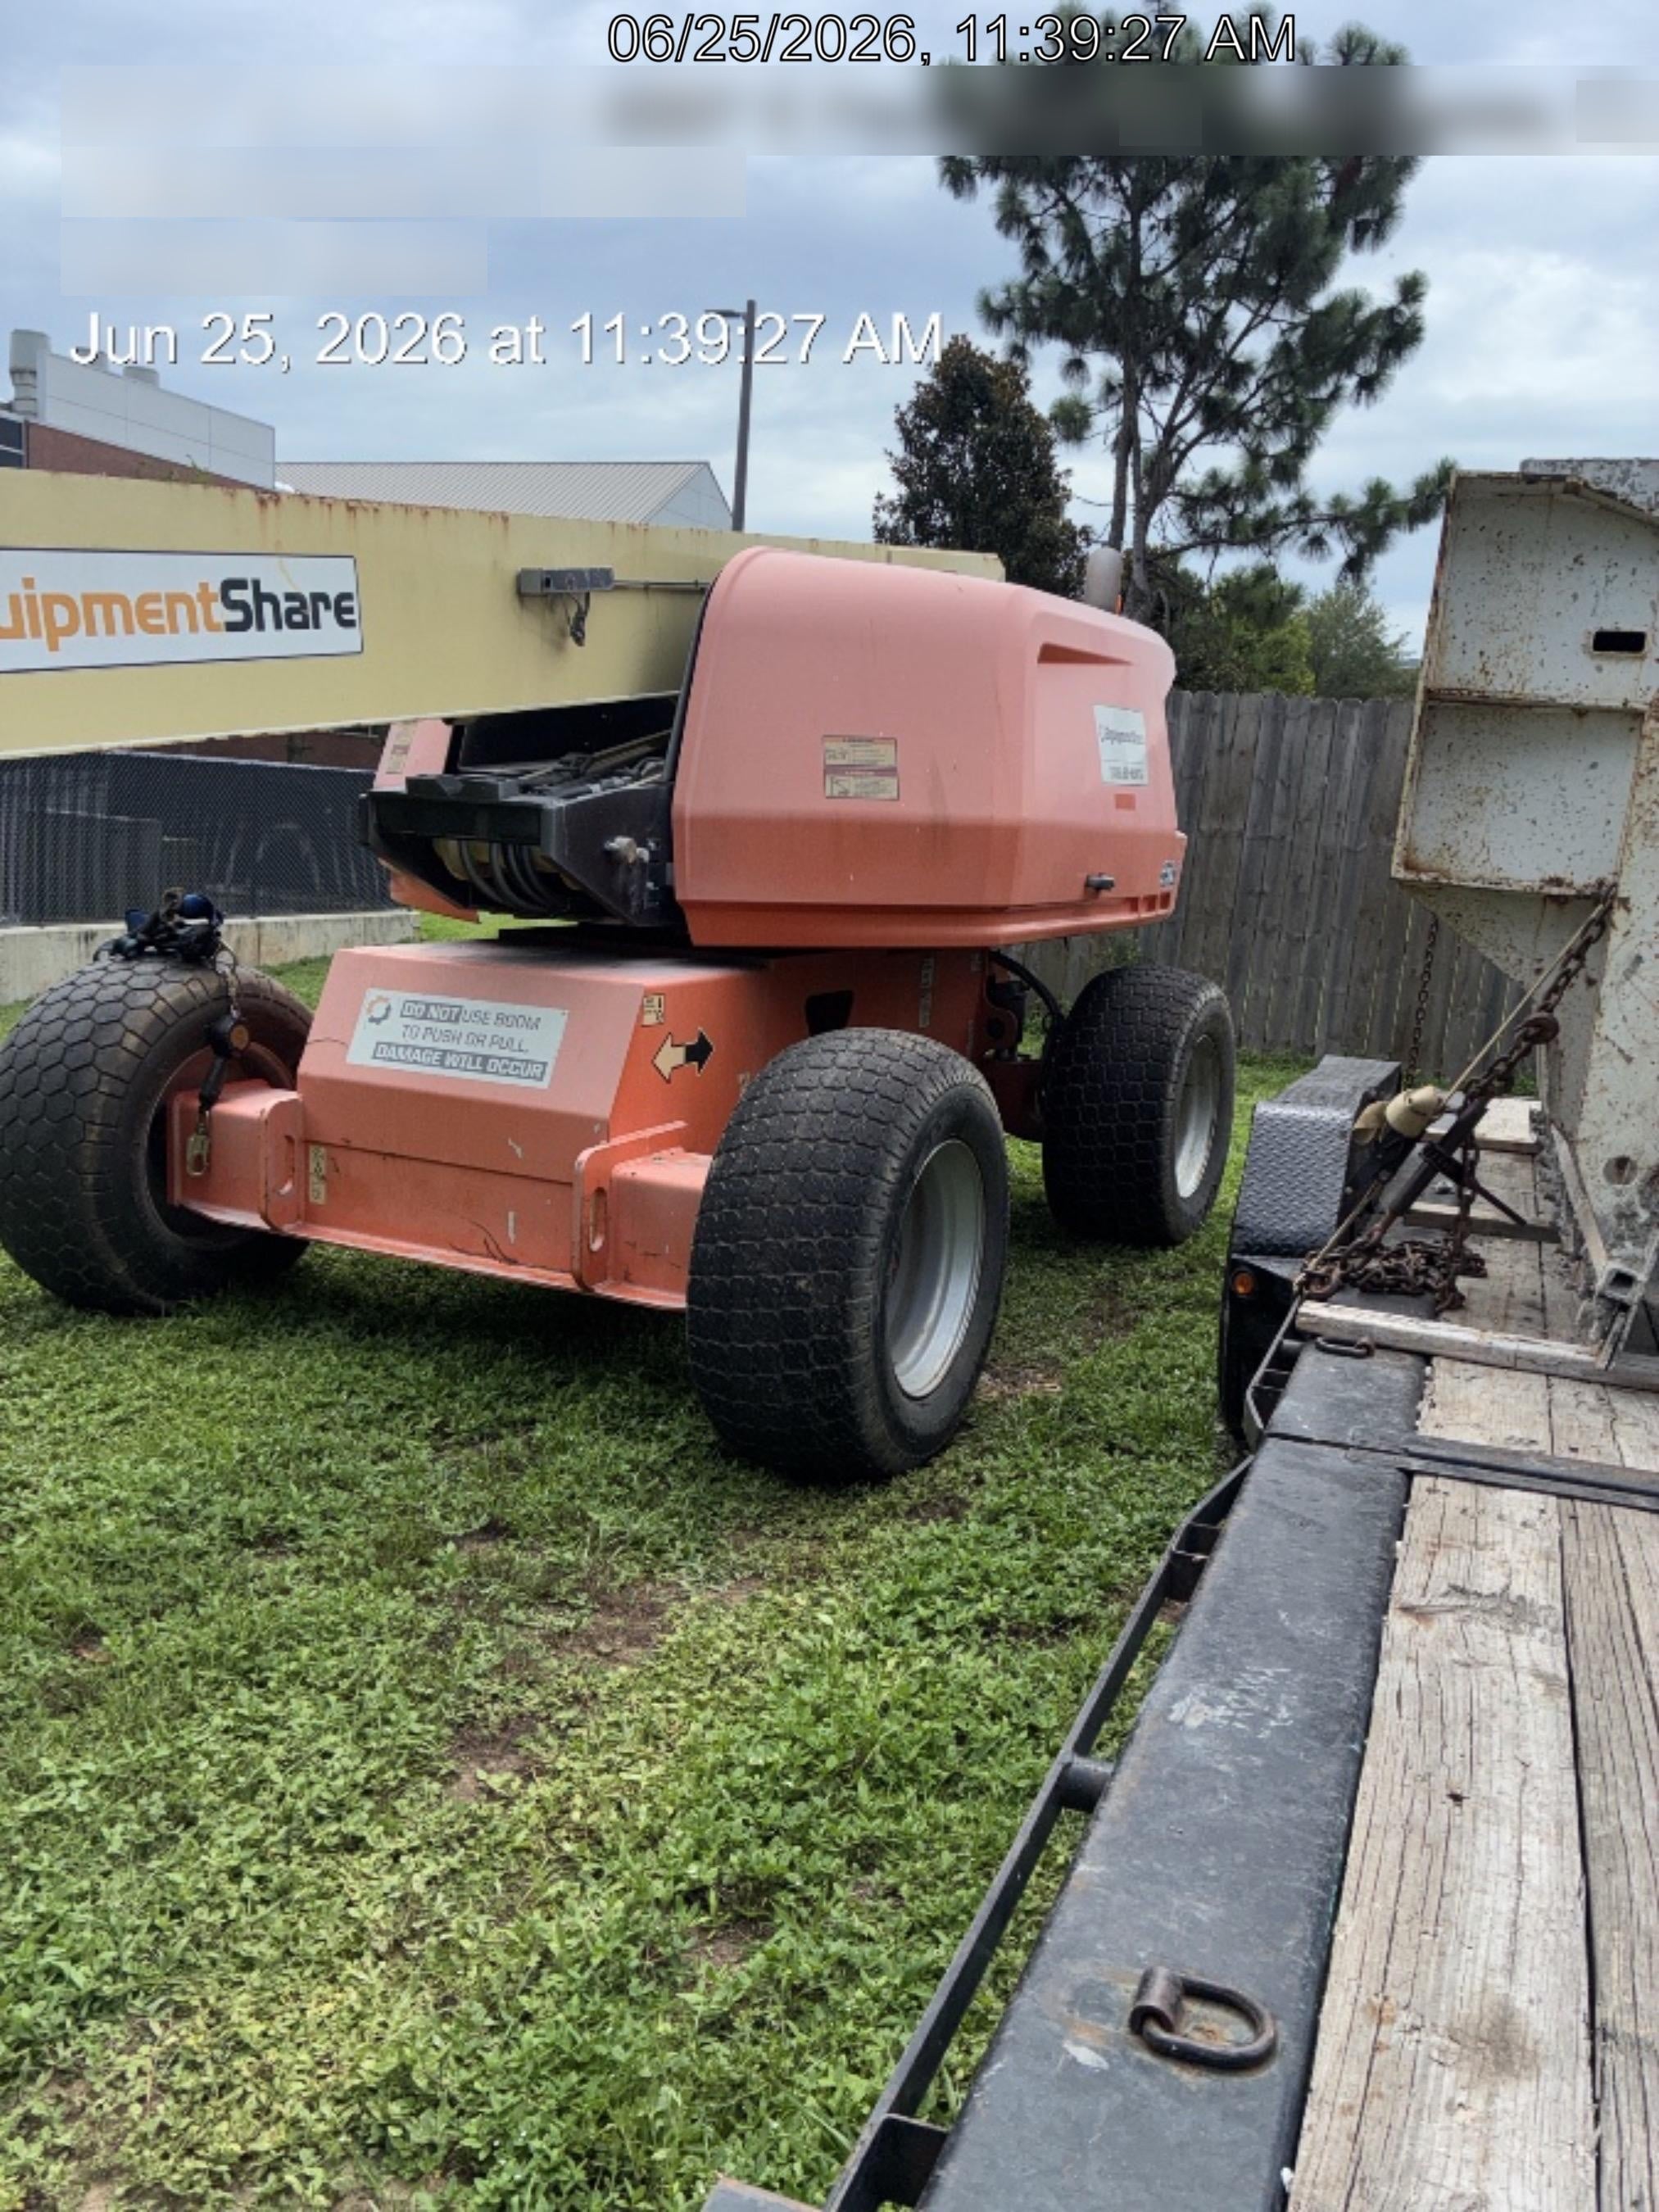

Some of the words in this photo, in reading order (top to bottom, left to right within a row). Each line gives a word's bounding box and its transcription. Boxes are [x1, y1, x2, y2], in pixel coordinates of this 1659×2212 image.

[402, 1001, 425, 1018] DO
[427, 1004, 460, 1022] NOT
[460, 1009, 492, 1026] USE
[401, 1024, 420, 1041] TO
[422, 1027, 463, 1045] PUSH
[464, 1031, 487, 1049] OR
[375, 1045, 442, 1064] DAMAGE
[444, 1052, 483, 1072] WILL
[486, 1058, 546, 1079] OCCUR
